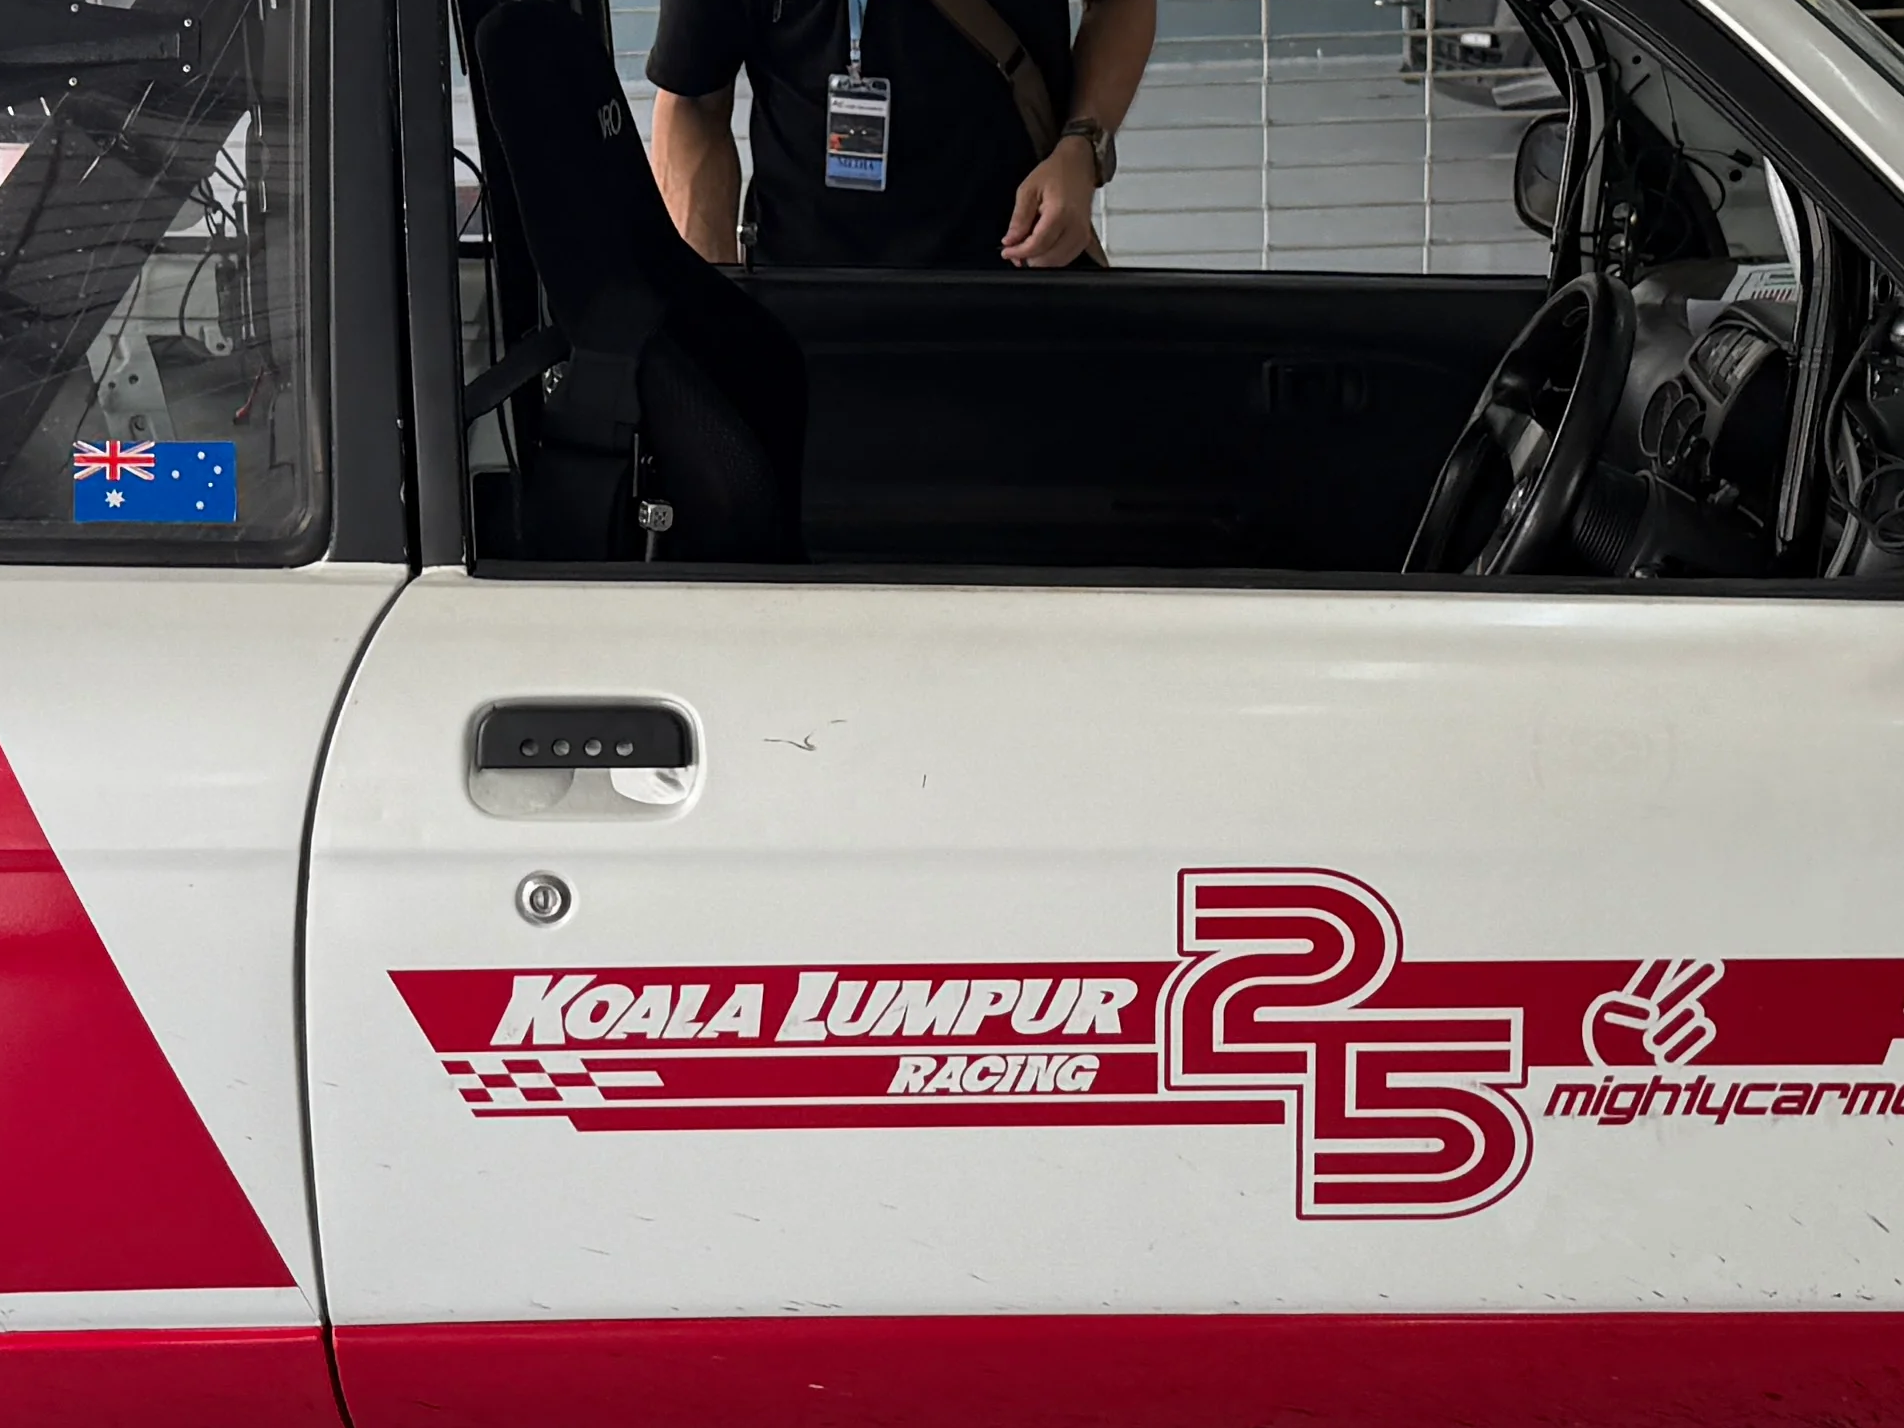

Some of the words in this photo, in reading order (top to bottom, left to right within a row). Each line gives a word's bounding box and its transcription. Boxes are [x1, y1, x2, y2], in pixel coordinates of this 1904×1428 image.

[490, 973, 764, 1046] KOALA
[774, 971, 1140, 1042] LUMPUR
[1158, 867, 1534, 1221] 25
[887, 1053, 1099, 1095] RACING
